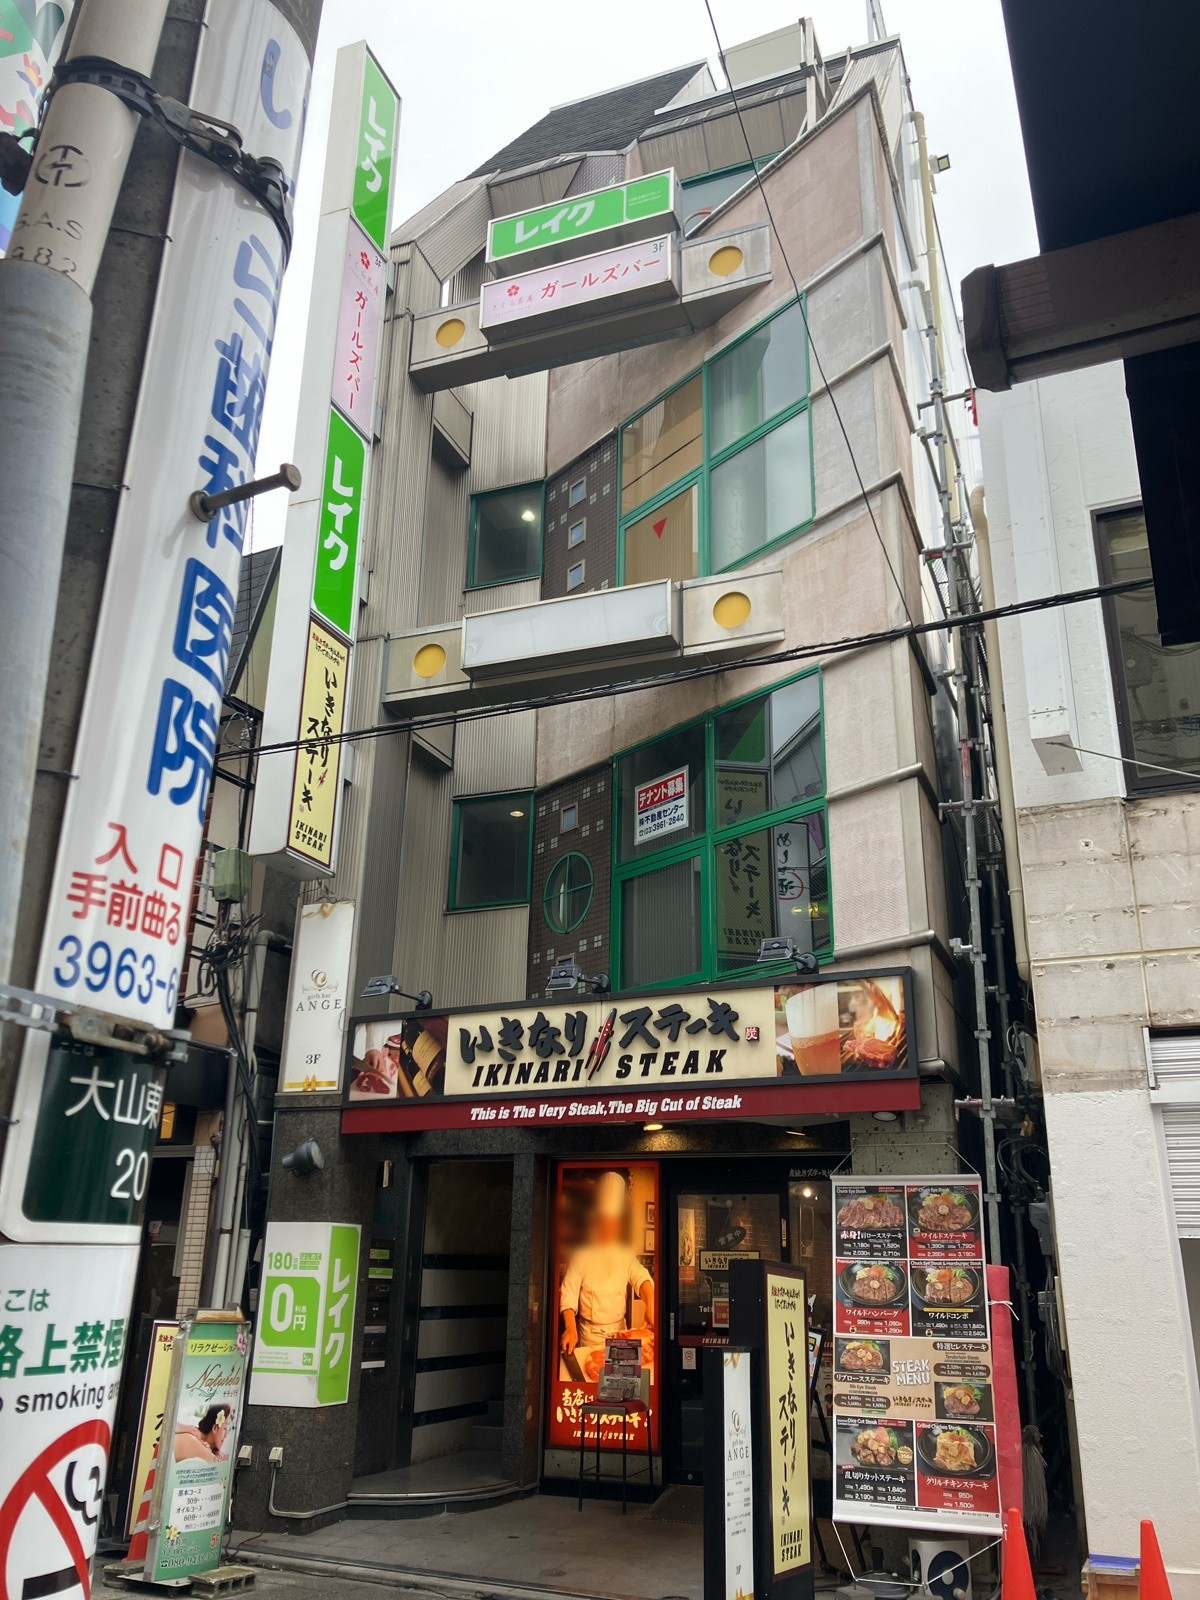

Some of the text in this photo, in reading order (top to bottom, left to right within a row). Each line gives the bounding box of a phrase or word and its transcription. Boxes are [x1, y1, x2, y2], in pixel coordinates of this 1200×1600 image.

[361, 95, 387, 193] レイク
[514, 200, 596, 245] レイク
[652, 241, 665, 253] 3F
[541, 259, 661, 300] ガールズバー
[347, 291, 369, 409] ガールズバー
[323, 455, 354, 571] レイク
[321, 666, 338, 768] いきなり
[301, 717, 319, 811] ステーキ
[639, 777, 684, 808] テナント募集
[294, 819, 328, 843] IKINARI
[294, 830, 325, 851] STEAK
[95, 821, 184, 891] 入口
[66, 871, 182, 947] 手前曲る
[295, 998, 342, 1011] ANGE
[459, 997, 740, 1064] いきなり ステーキ
[745, 1026, 760, 1042] 炭
[305, 1053, 321, 1065] 3F
[471, 1049, 728, 1088] IKINARI STEAK
[65, 1066, 163, 1129] 大山東
[470, 1107, 497, 1121] This
[498, 1106, 510, 1119] is
[512, 1105, 536, 1118] The
[538, 1104, 566, 1120] Very
[635, 1099, 658, 1116] Big
[660, 1098, 683, 1112] Cut
[685, 1096, 700, 1110] of
[701, 1094, 741, 1109] Steak
[110, 1149, 148, 1201] 20
[921, 1232, 968, 1240] ワイルドステーキ
[268, 1252, 292, 1271] 180
[0, 1289, 50, 1312] こは
[270, 1283, 294, 1332] 0
[293, 1314, 306, 1332] 円
[325, 1258, 350, 1369] レイク
[845, 1309, 899, 1318] ワイルドハンバーグ
[936, 1342, 987, 1351] 特選ヒレステーキ
[892, 1359, 930, 1373] STEAK
[783, 1320, 799, 1450] いきなり
[836, 1374, 889, 1384] リブロースステーキ
[895, 1372, 930, 1386] MENU
[15, 1382, 105, 1414] smoking
[561, 1388, 594, 1407] 当店は
[727, 1446, 750, 1462] ANGE
[778, 1393, 790, 1517] ステーキ
[844, 1471, 906, 1484] 乱切りカットステーキ
[926, 1477, 989, 1490] グリルチキンステーキ
[176, 1505, 202, 1514] オイルコース
[780, 1528, 803, 1547] IKINARI
[781, 1543, 802, 1562] STEAK
